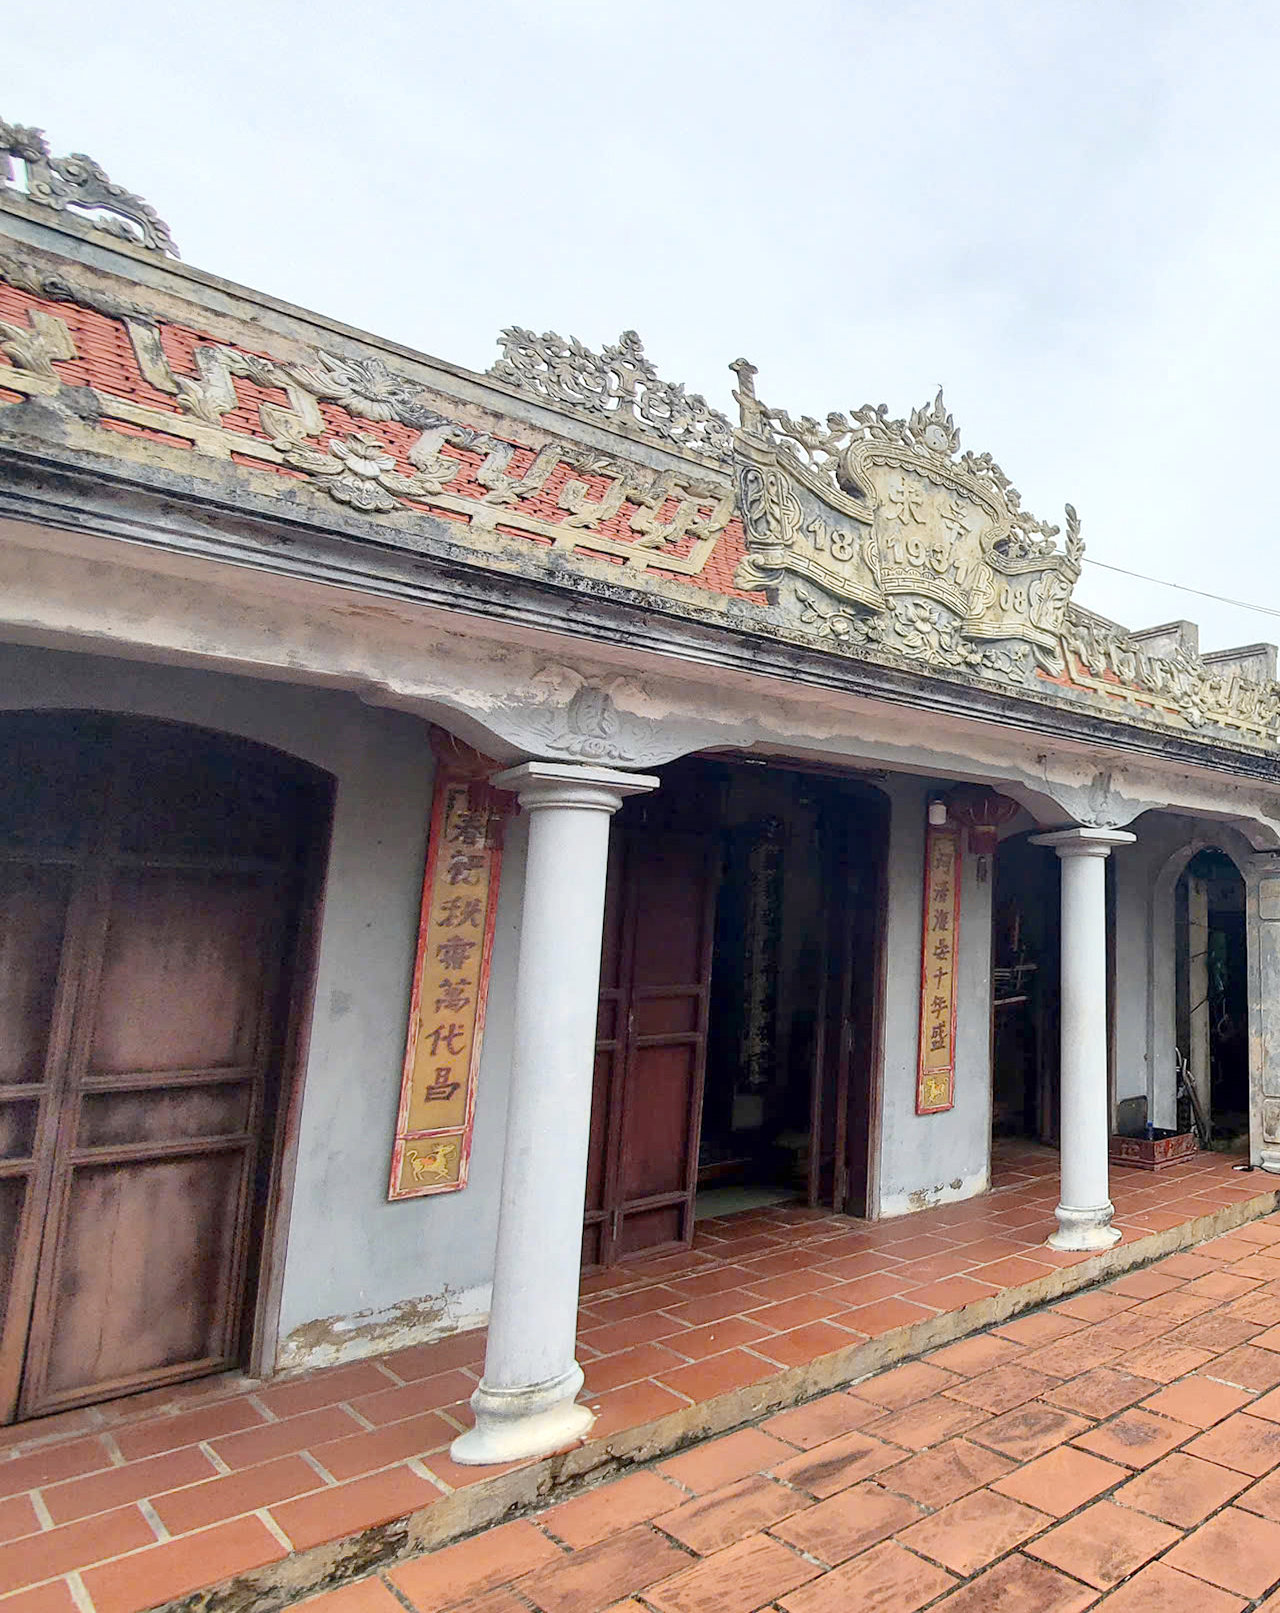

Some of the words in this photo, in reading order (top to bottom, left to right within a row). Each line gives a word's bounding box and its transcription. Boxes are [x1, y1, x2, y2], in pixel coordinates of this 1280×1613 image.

[807, 517, 855, 562] 18
[886, 534, 969, 585] 1931
[999, 585, 1026, 614] 08
